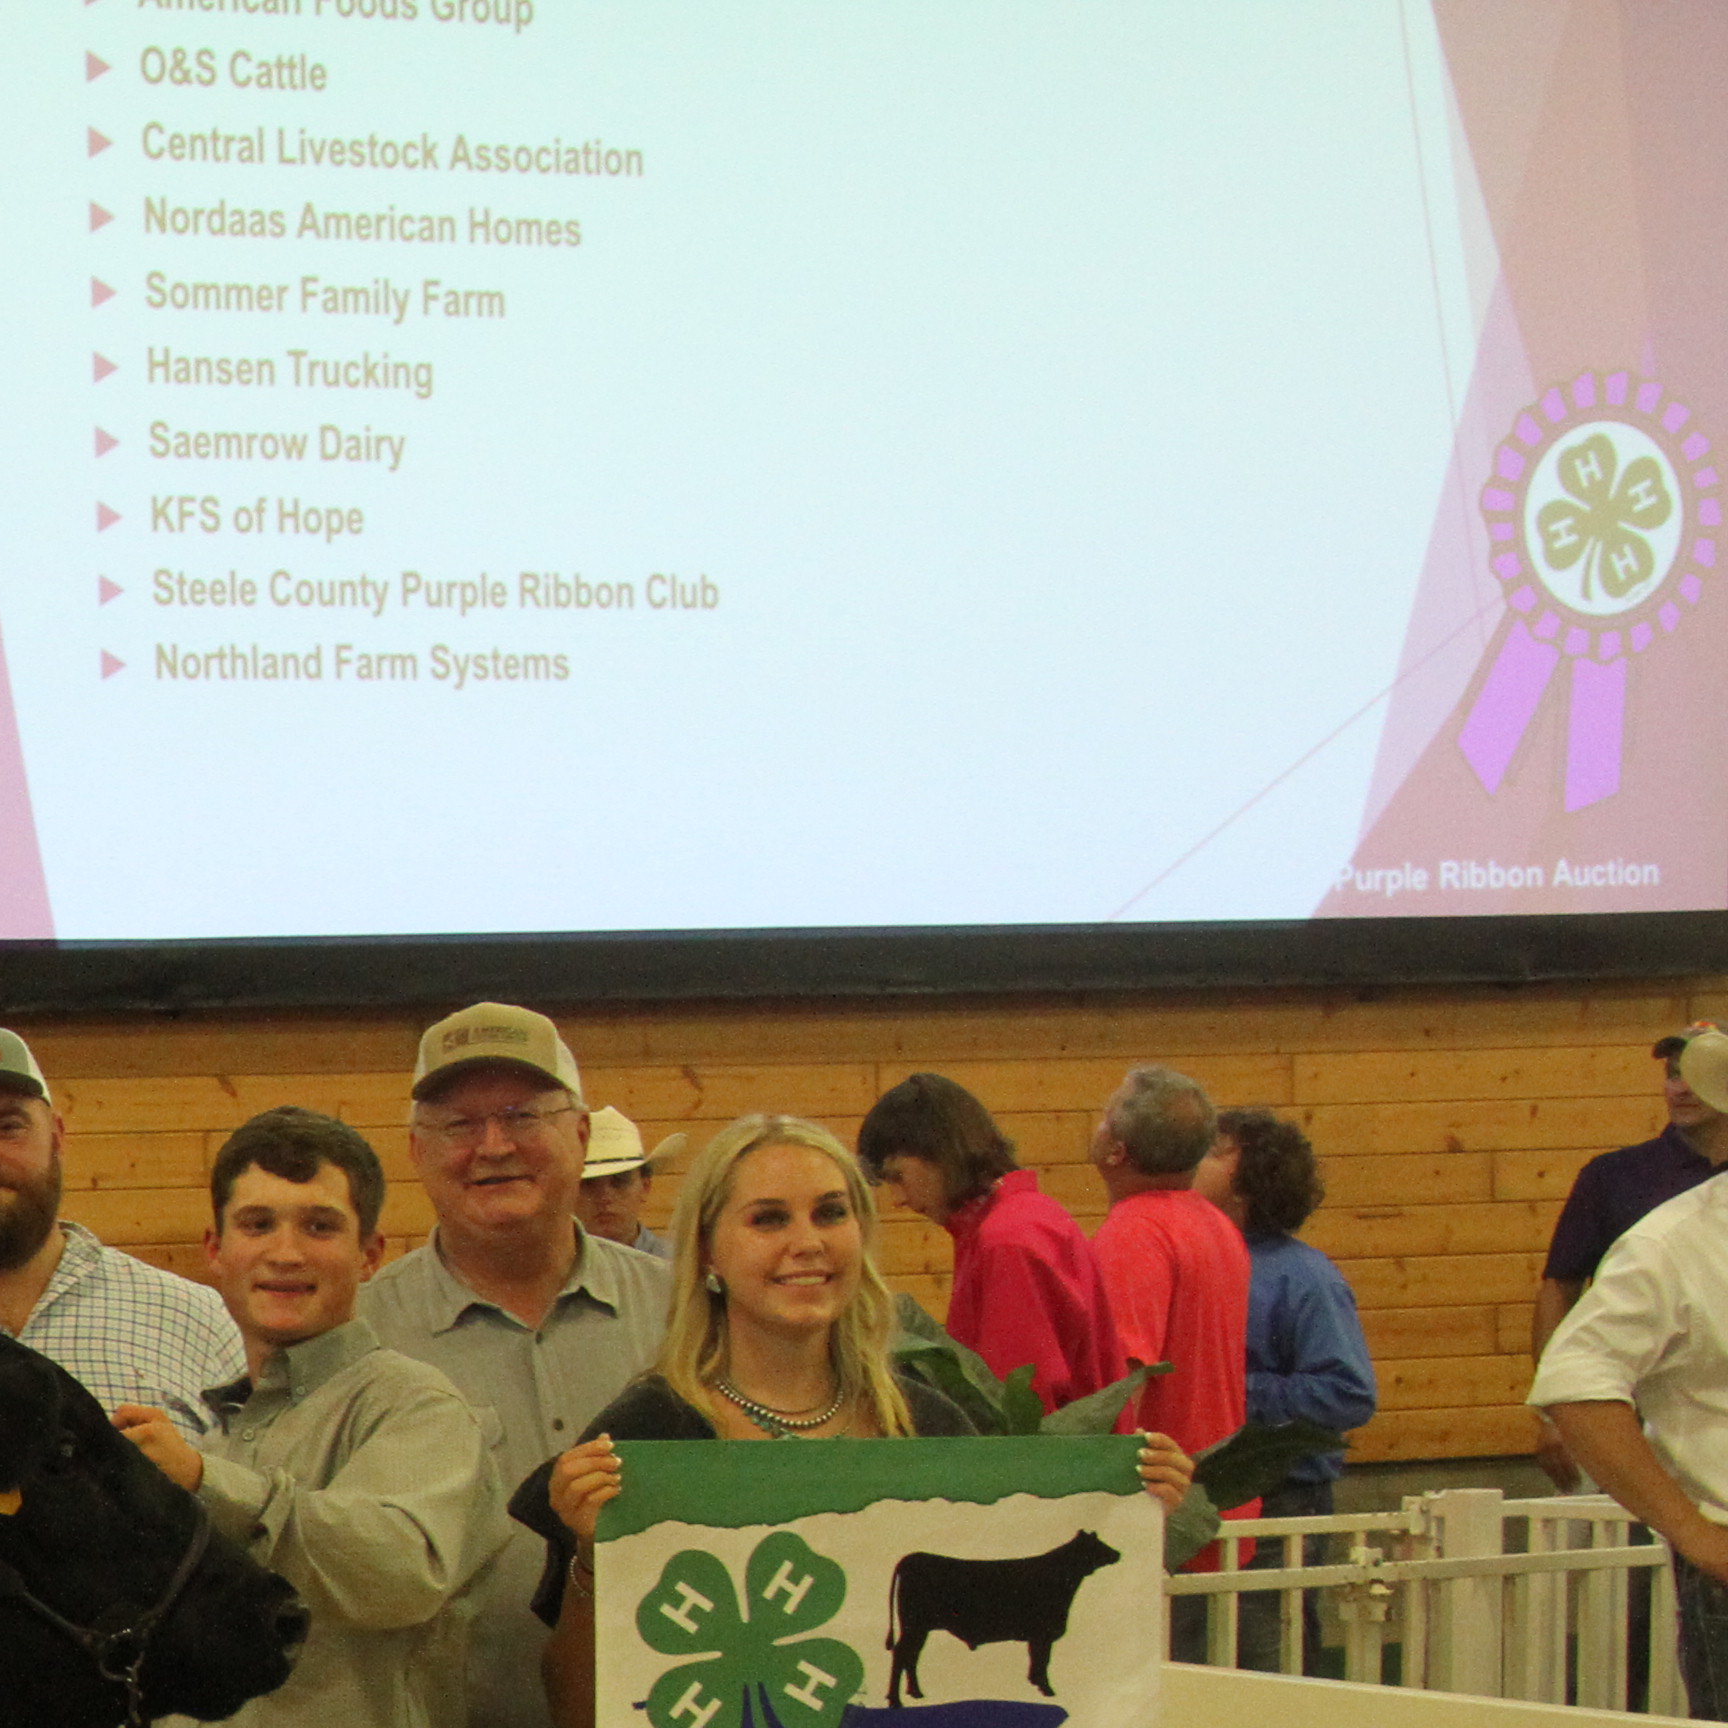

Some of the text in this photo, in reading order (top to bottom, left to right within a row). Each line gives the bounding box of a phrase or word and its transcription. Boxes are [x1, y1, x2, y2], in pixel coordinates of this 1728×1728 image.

[141, 46, 328, 92] O&S Cattle
[142, 122, 644, 177] Central Livestock Association
[143, 198, 582, 247] Nordaas American Homes
[144, 271, 506, 324] Sommer Family Farm
[147, 346, 434, 401] Hansen Trucking
[149, 421, 406, 472] Saemrow Dairy
[151, 496, 364, 543] KFS of Hope
[152, 570, 719, 617] Steele County Purple Ribbon Club
[154, 644, 570, 689] Northland Farm Systems
[1334, 857, 1660, 896] Purple Ribbon Auction
